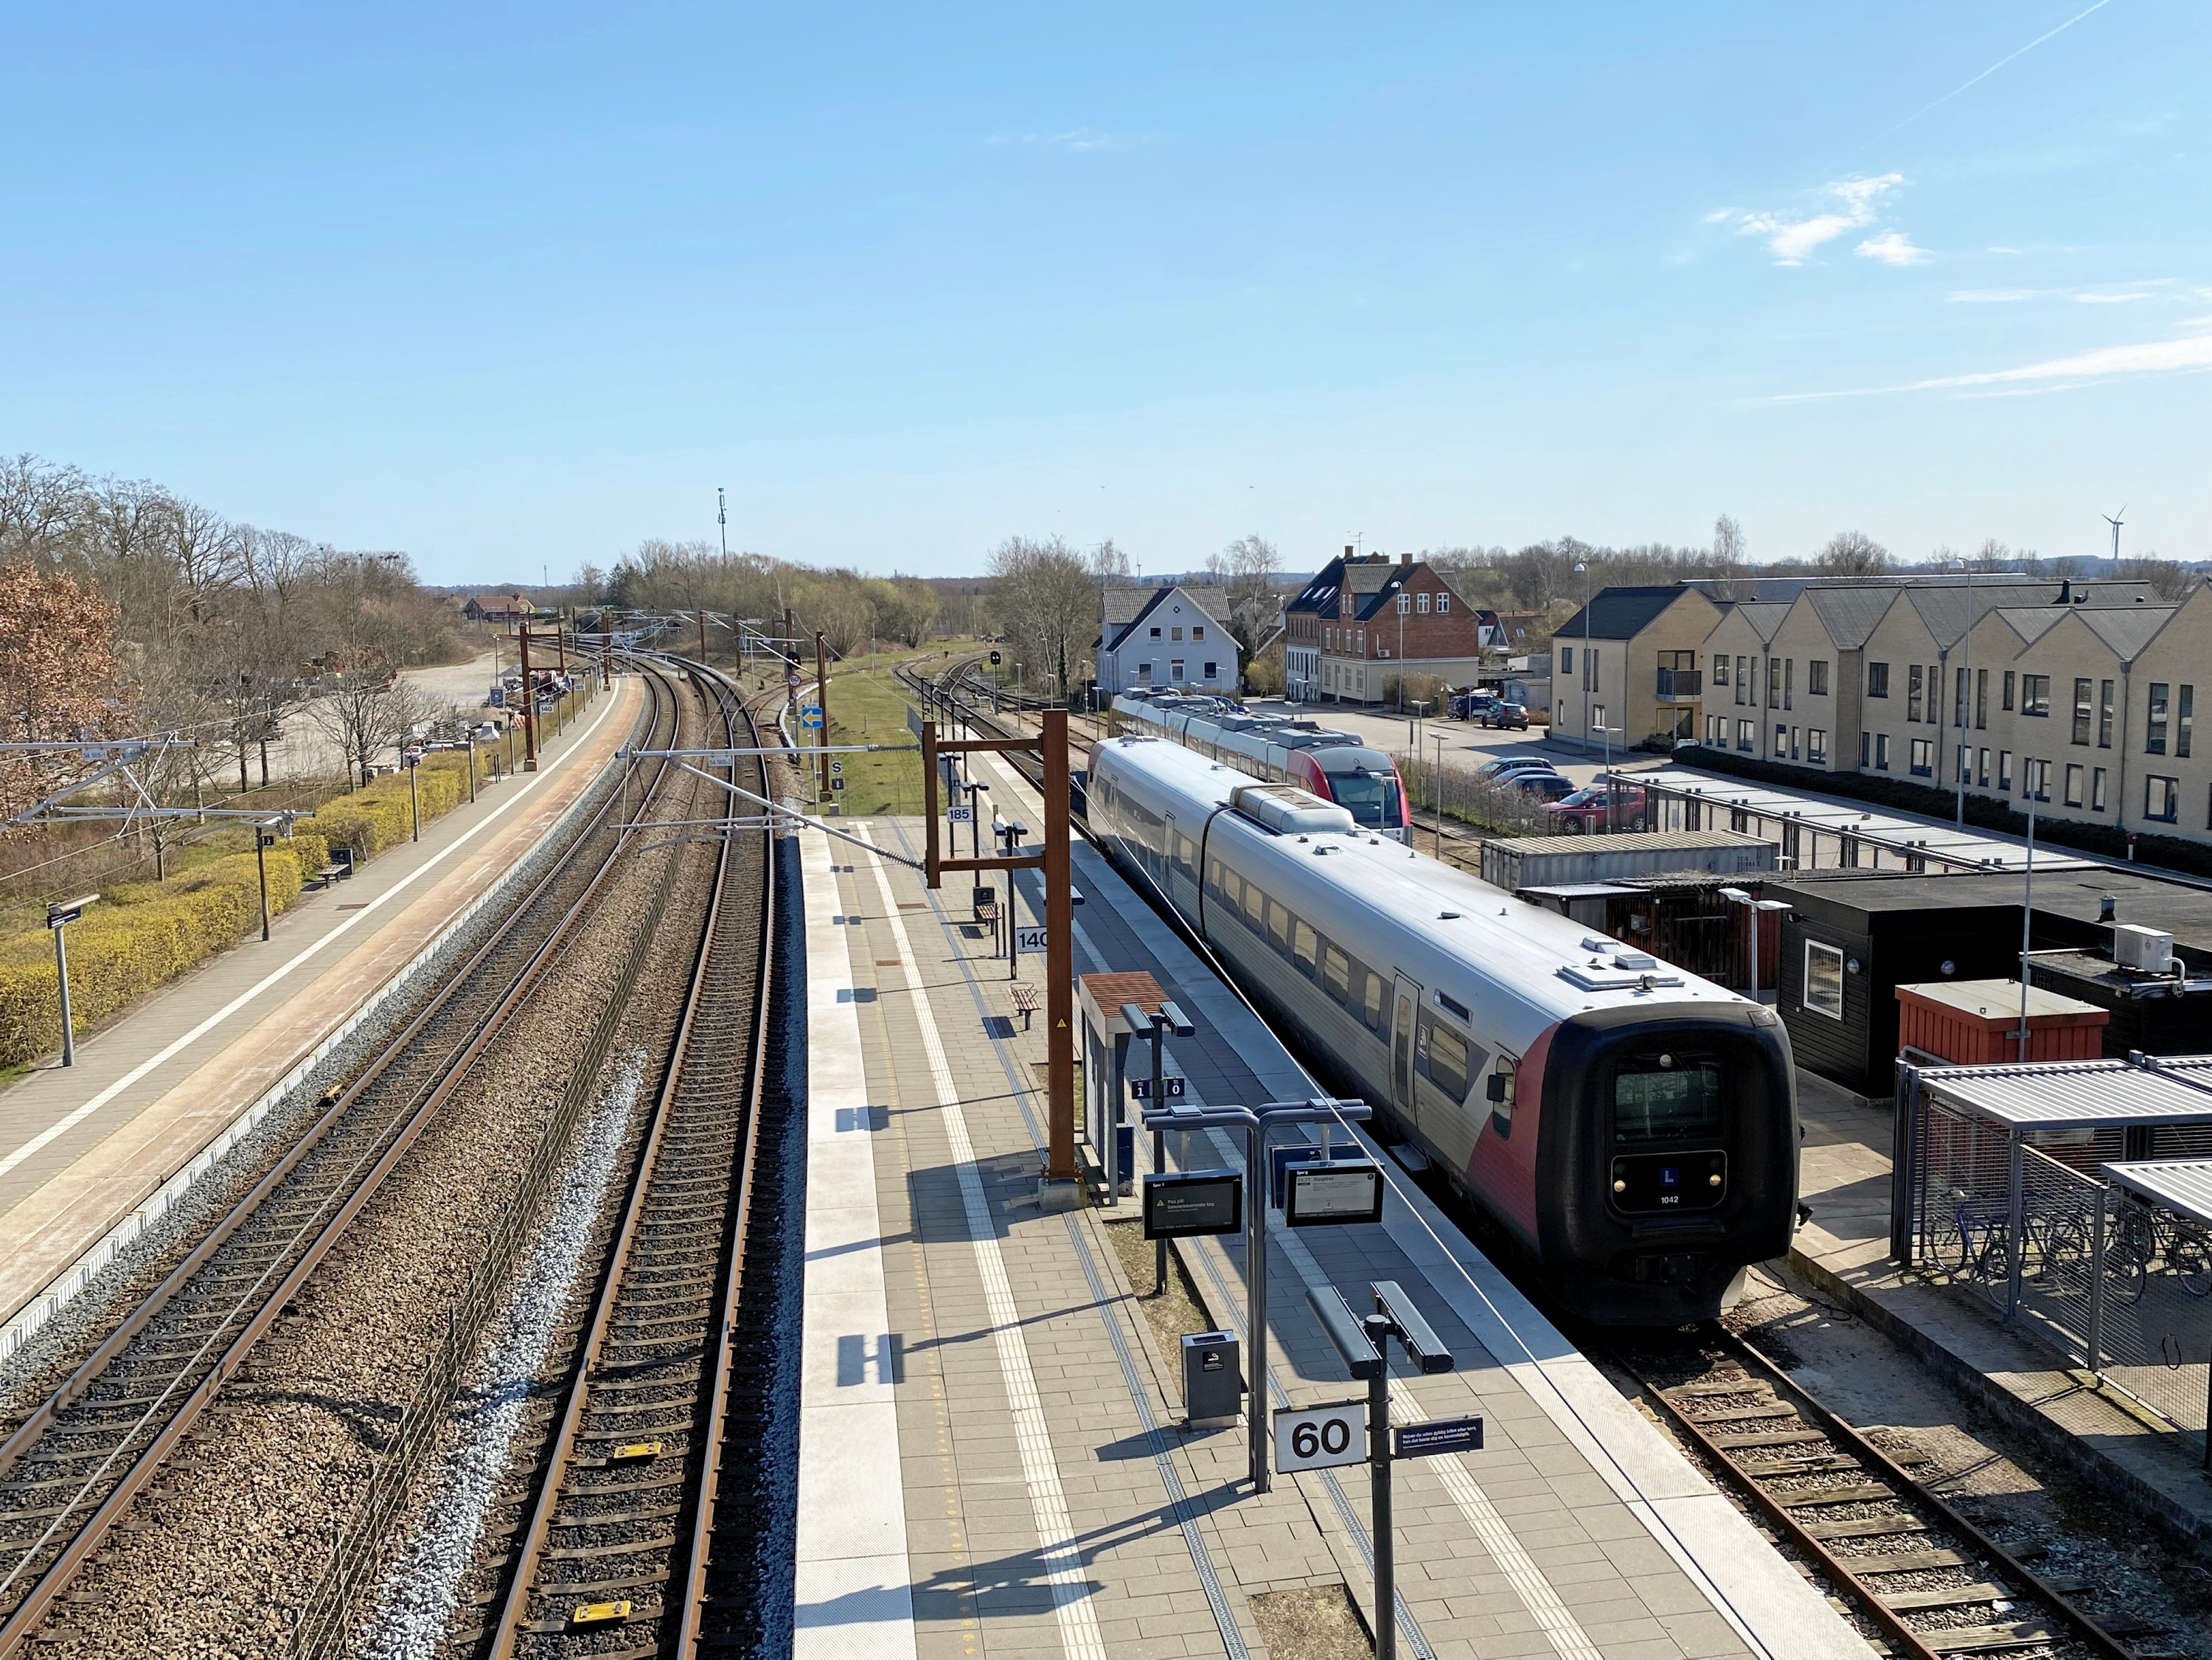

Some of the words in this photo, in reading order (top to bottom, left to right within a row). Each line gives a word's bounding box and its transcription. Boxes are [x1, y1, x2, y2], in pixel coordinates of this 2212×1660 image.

[832, 762, 841, 773] S
[949, 809, 969, 819] 185
[1137, 1087, 1144, 1097] 1
[1172, 1085, 1180, 1094] 0
[1665, 1170, 1674, 1182] L
[1660, 1195, 1679, 1204] 1042
[1292, 1418, 1350, 1458] 60
